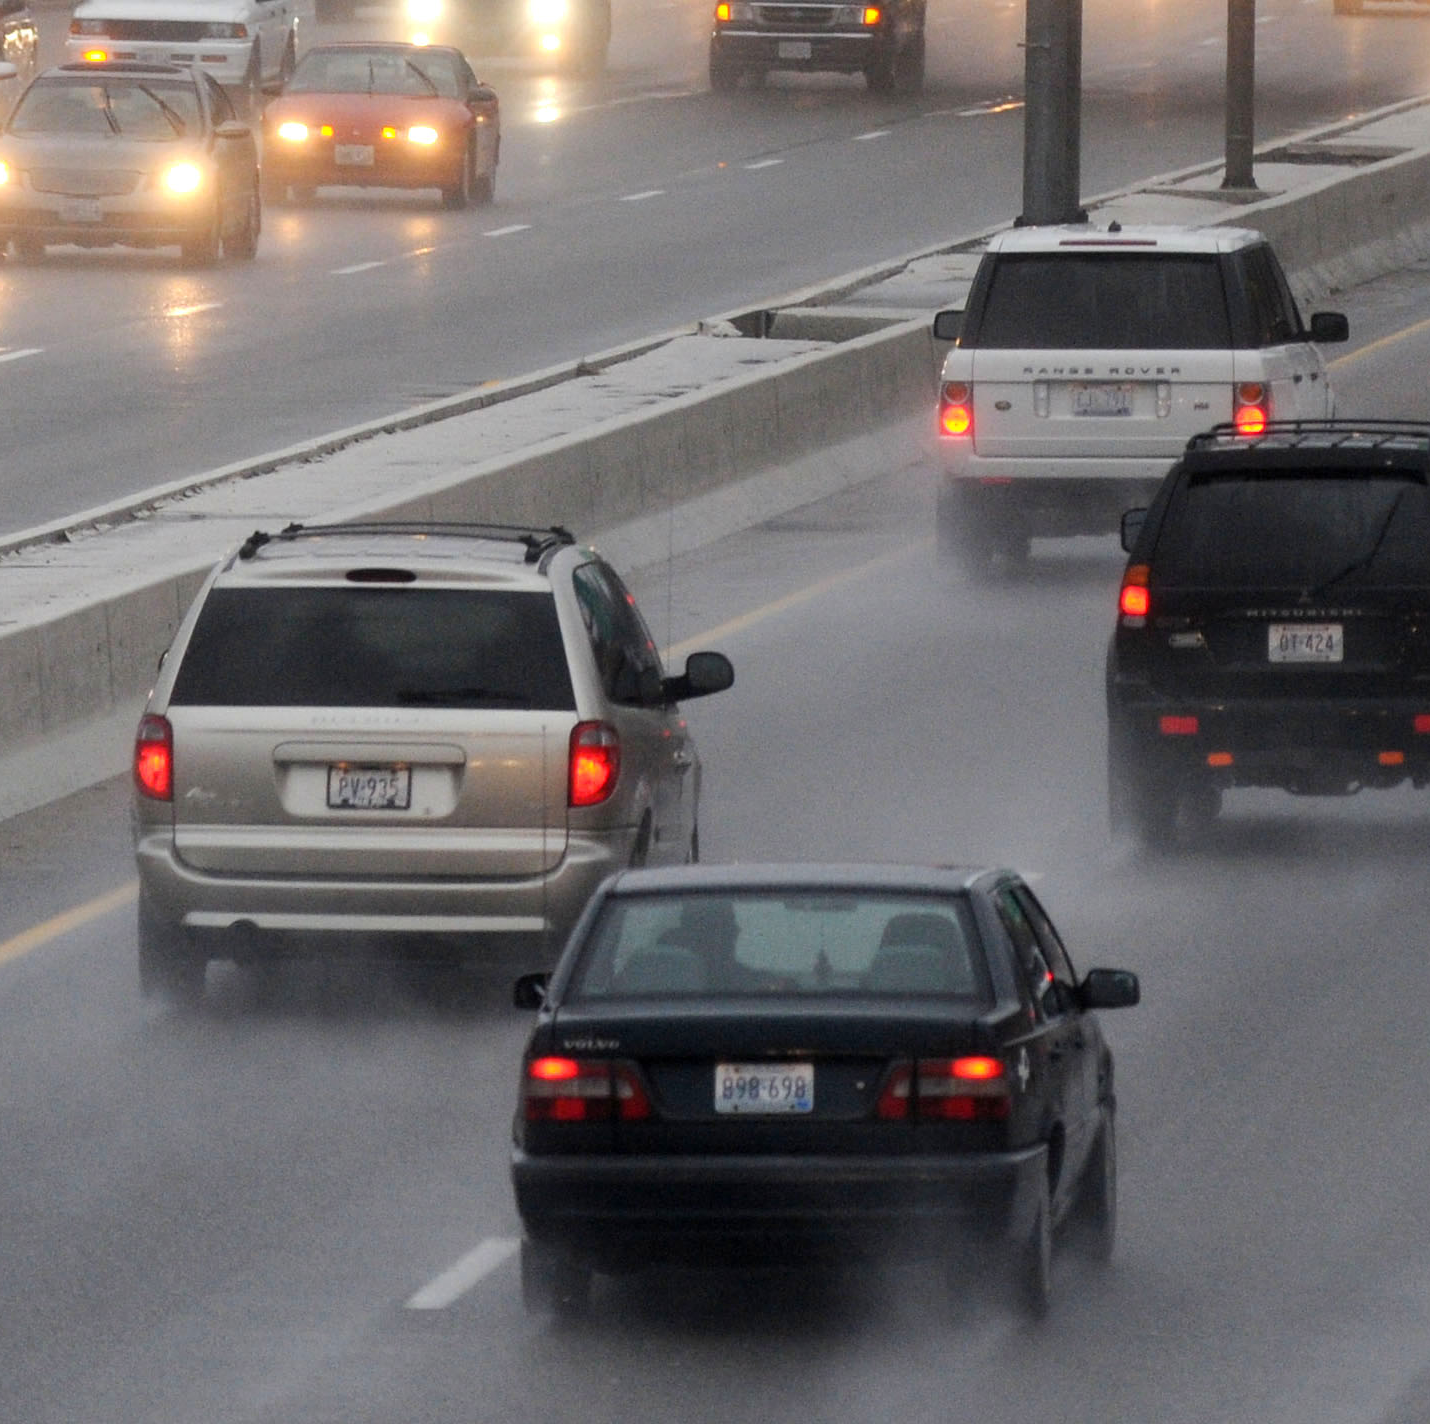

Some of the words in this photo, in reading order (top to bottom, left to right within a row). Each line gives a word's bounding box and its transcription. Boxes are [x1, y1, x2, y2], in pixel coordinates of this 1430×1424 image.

[1023, 367, 1094, 375] RANGE
[1108, 367, 1182, 375] ROVER
[1246, 608, 1362, 617] MITSUBISHI
[563, 1039, 620, 1050] VOLVO
